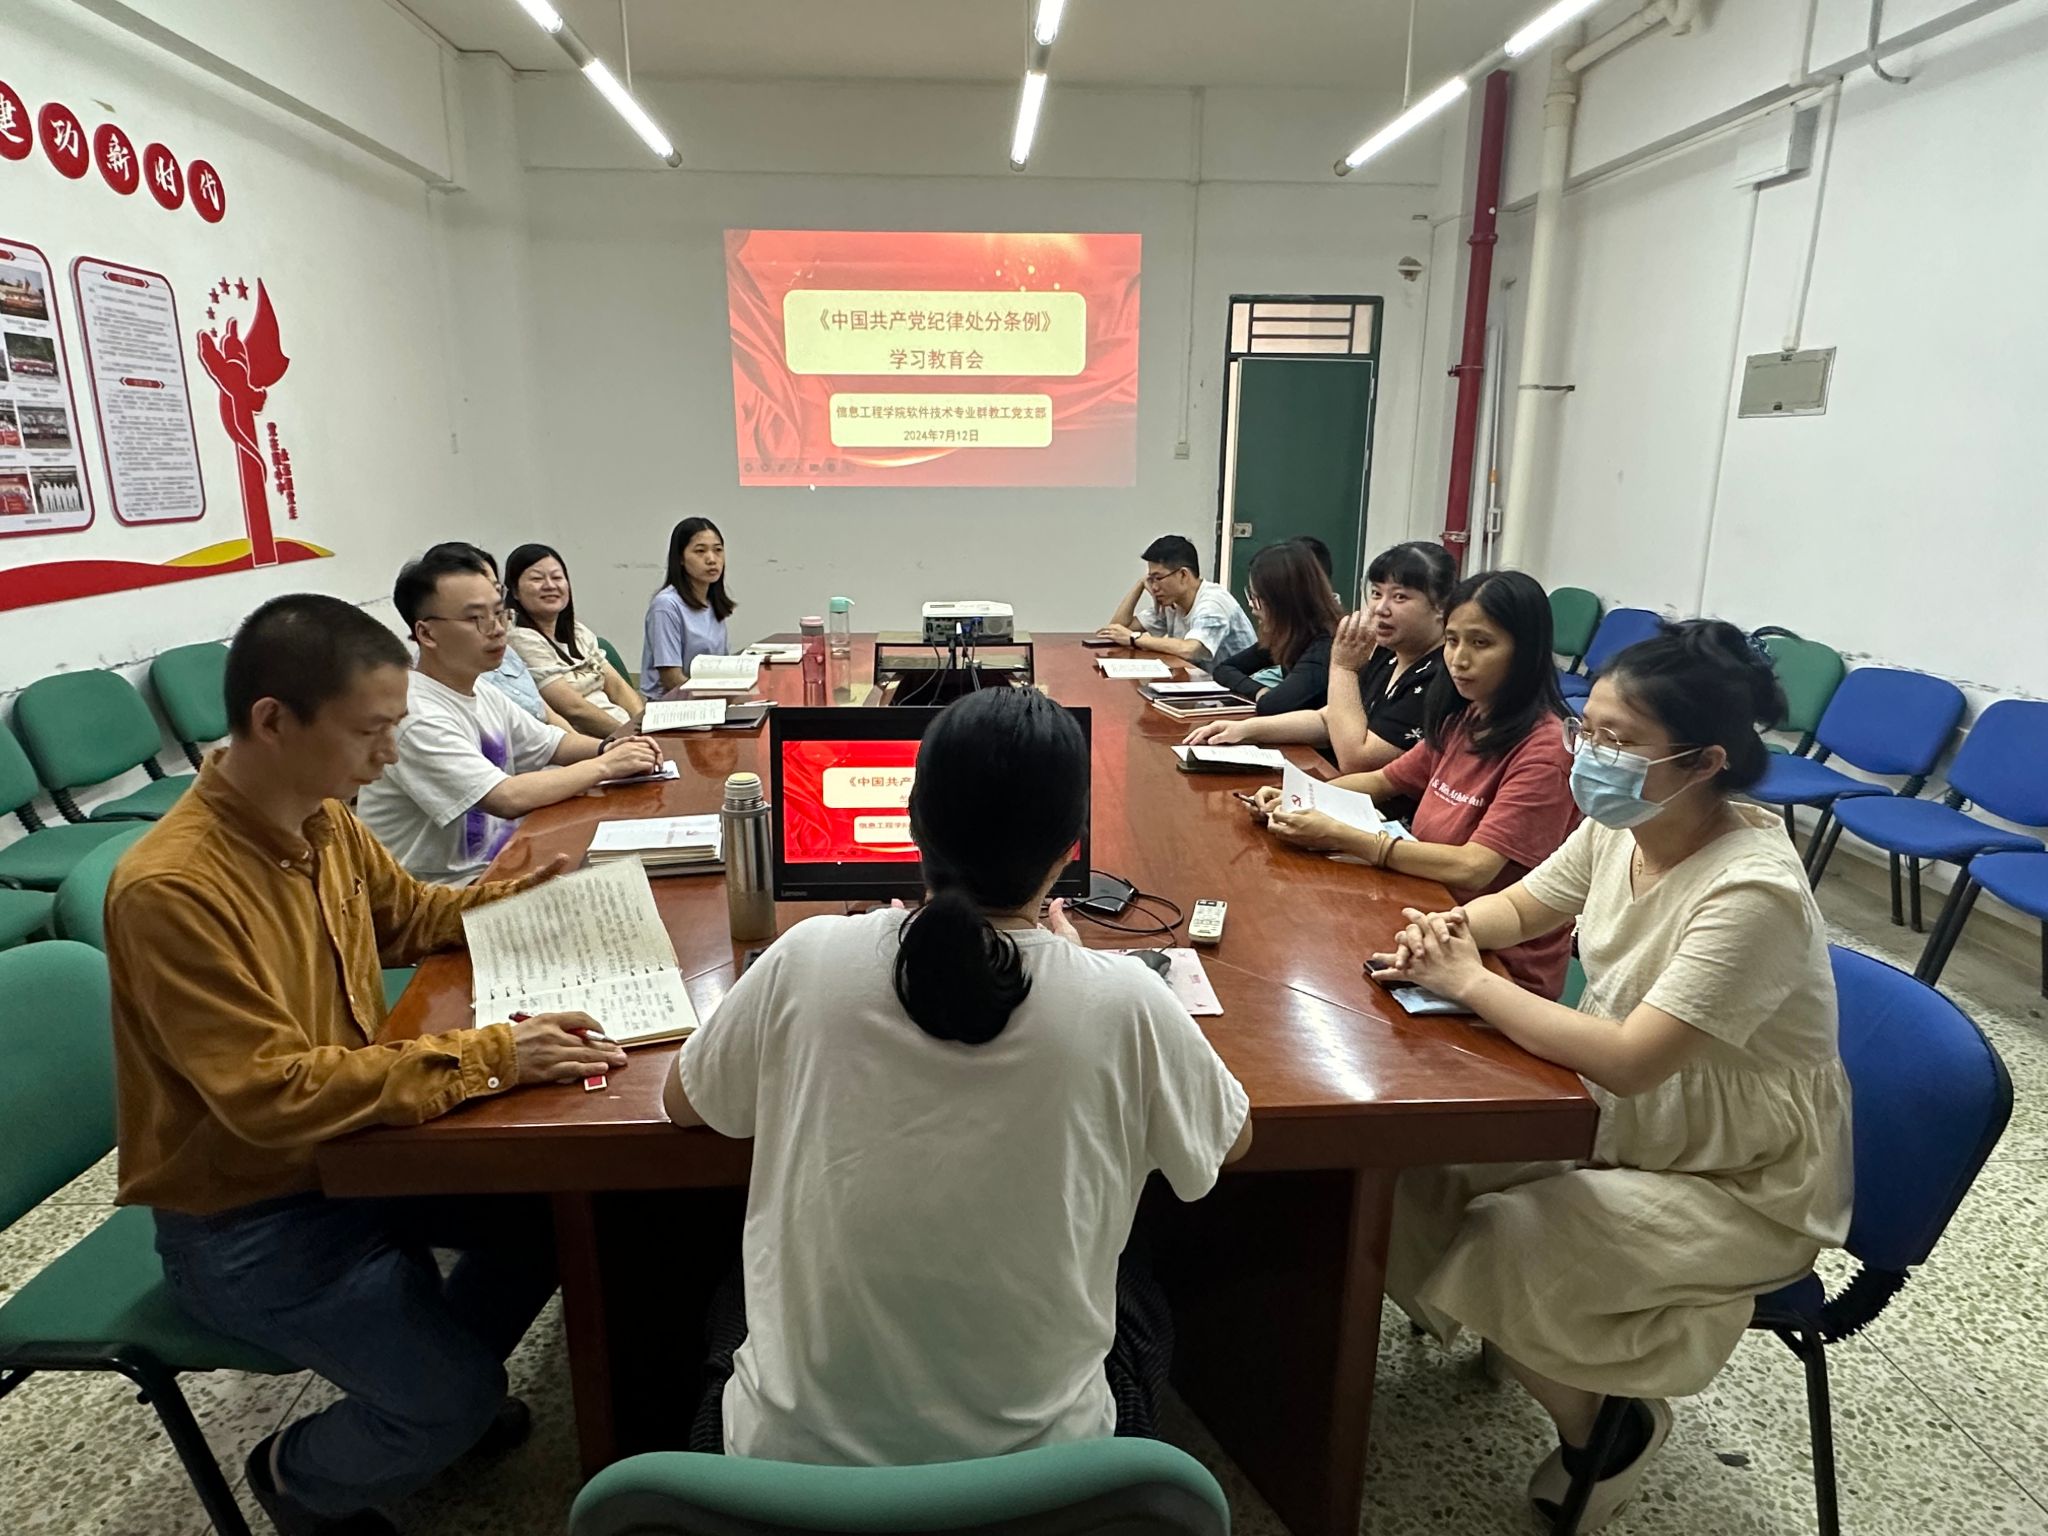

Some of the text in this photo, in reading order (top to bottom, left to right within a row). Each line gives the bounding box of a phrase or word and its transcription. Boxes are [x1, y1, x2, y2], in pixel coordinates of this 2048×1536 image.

[818, 309, 1054, 333] 《中国共产党纪律处分条例》
[889, 348, 985, 370] 学习教育会
[836, 404, 1047, 420] 信息工程学院软件技术专业群教工党支部
[903, 429, 980, 443] 2024年7月12日
